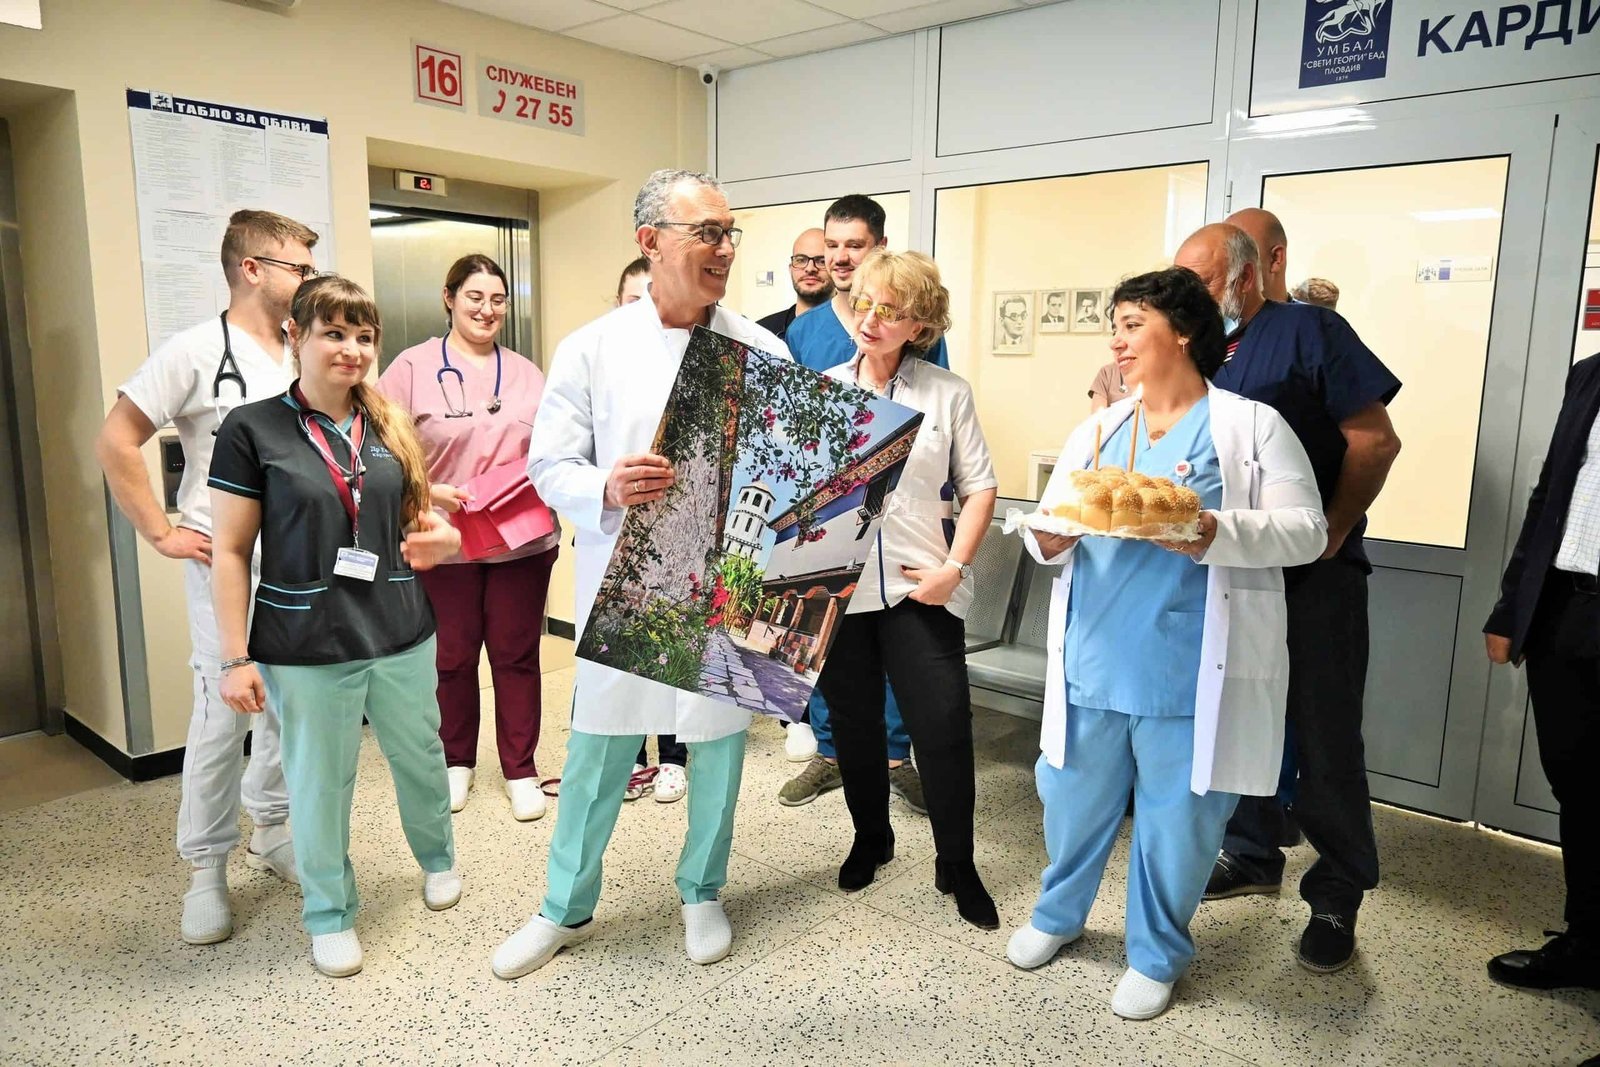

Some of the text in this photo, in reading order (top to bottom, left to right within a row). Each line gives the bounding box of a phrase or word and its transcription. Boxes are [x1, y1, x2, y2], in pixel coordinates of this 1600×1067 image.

[1317, 39, 1373, 57] УМБАЛ
[1368, 50, 1386, 60] ЕАД
[421, 55, 458, 97] 16
[1324, 63, 1361, 75] ПЛОВДИВ
[486, 65, 577, 99] СЛУЖЕБЕН
[175, 101, 232, 120] ТАБЛО
[235, 112, 257, 124] ЗА
[515, 95, 573, 127] 27 55
